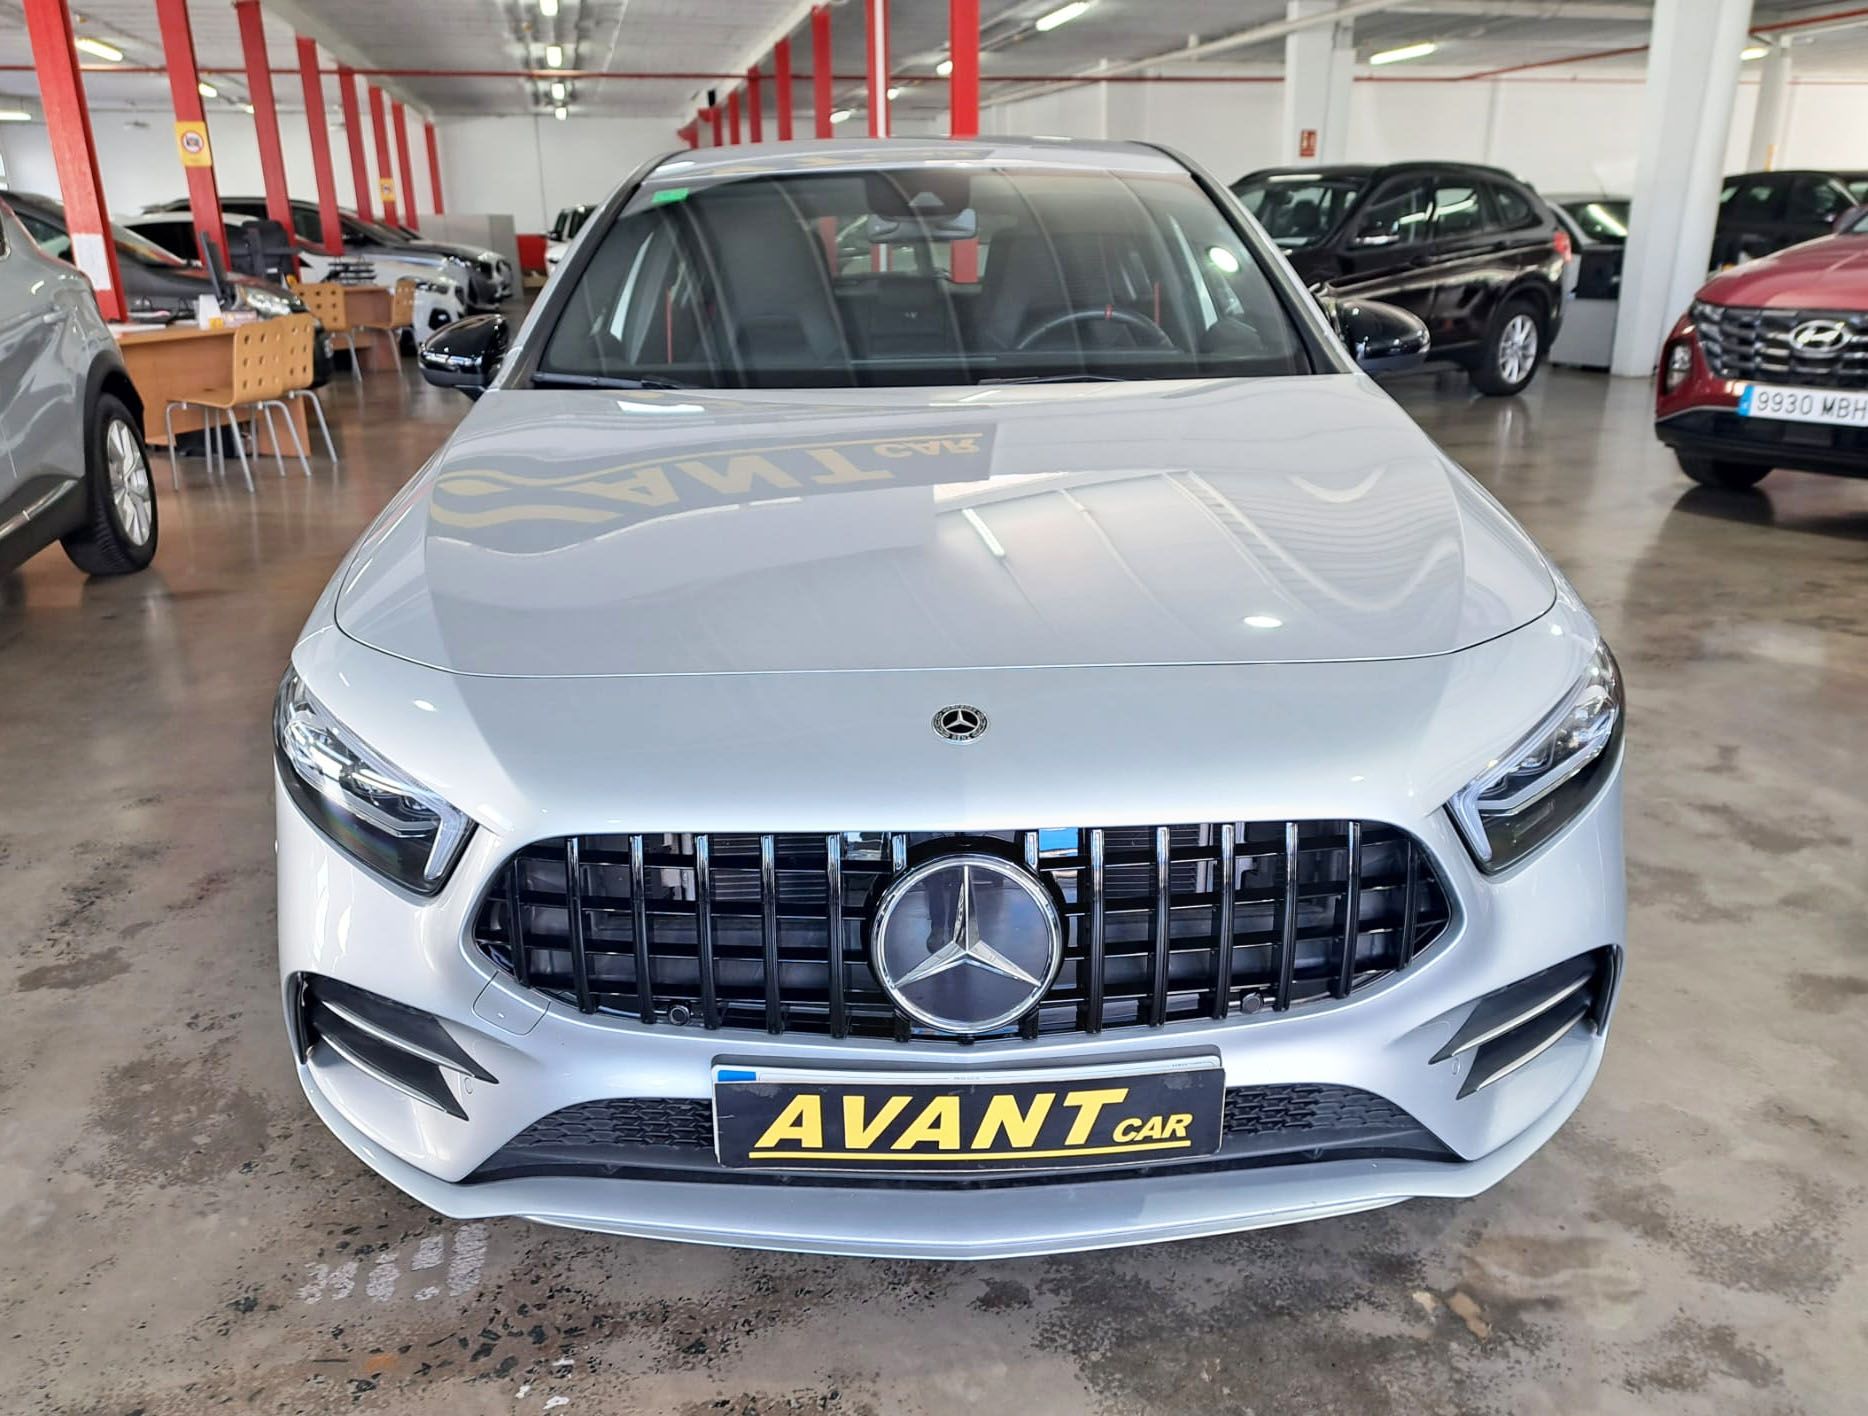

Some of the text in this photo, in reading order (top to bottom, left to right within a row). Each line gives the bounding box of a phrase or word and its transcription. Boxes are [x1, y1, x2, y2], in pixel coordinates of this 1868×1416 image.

[1757, 391, 1868, 420] 9930 MBH
[755, 1088, 1193, 1149] AVANT CAR
